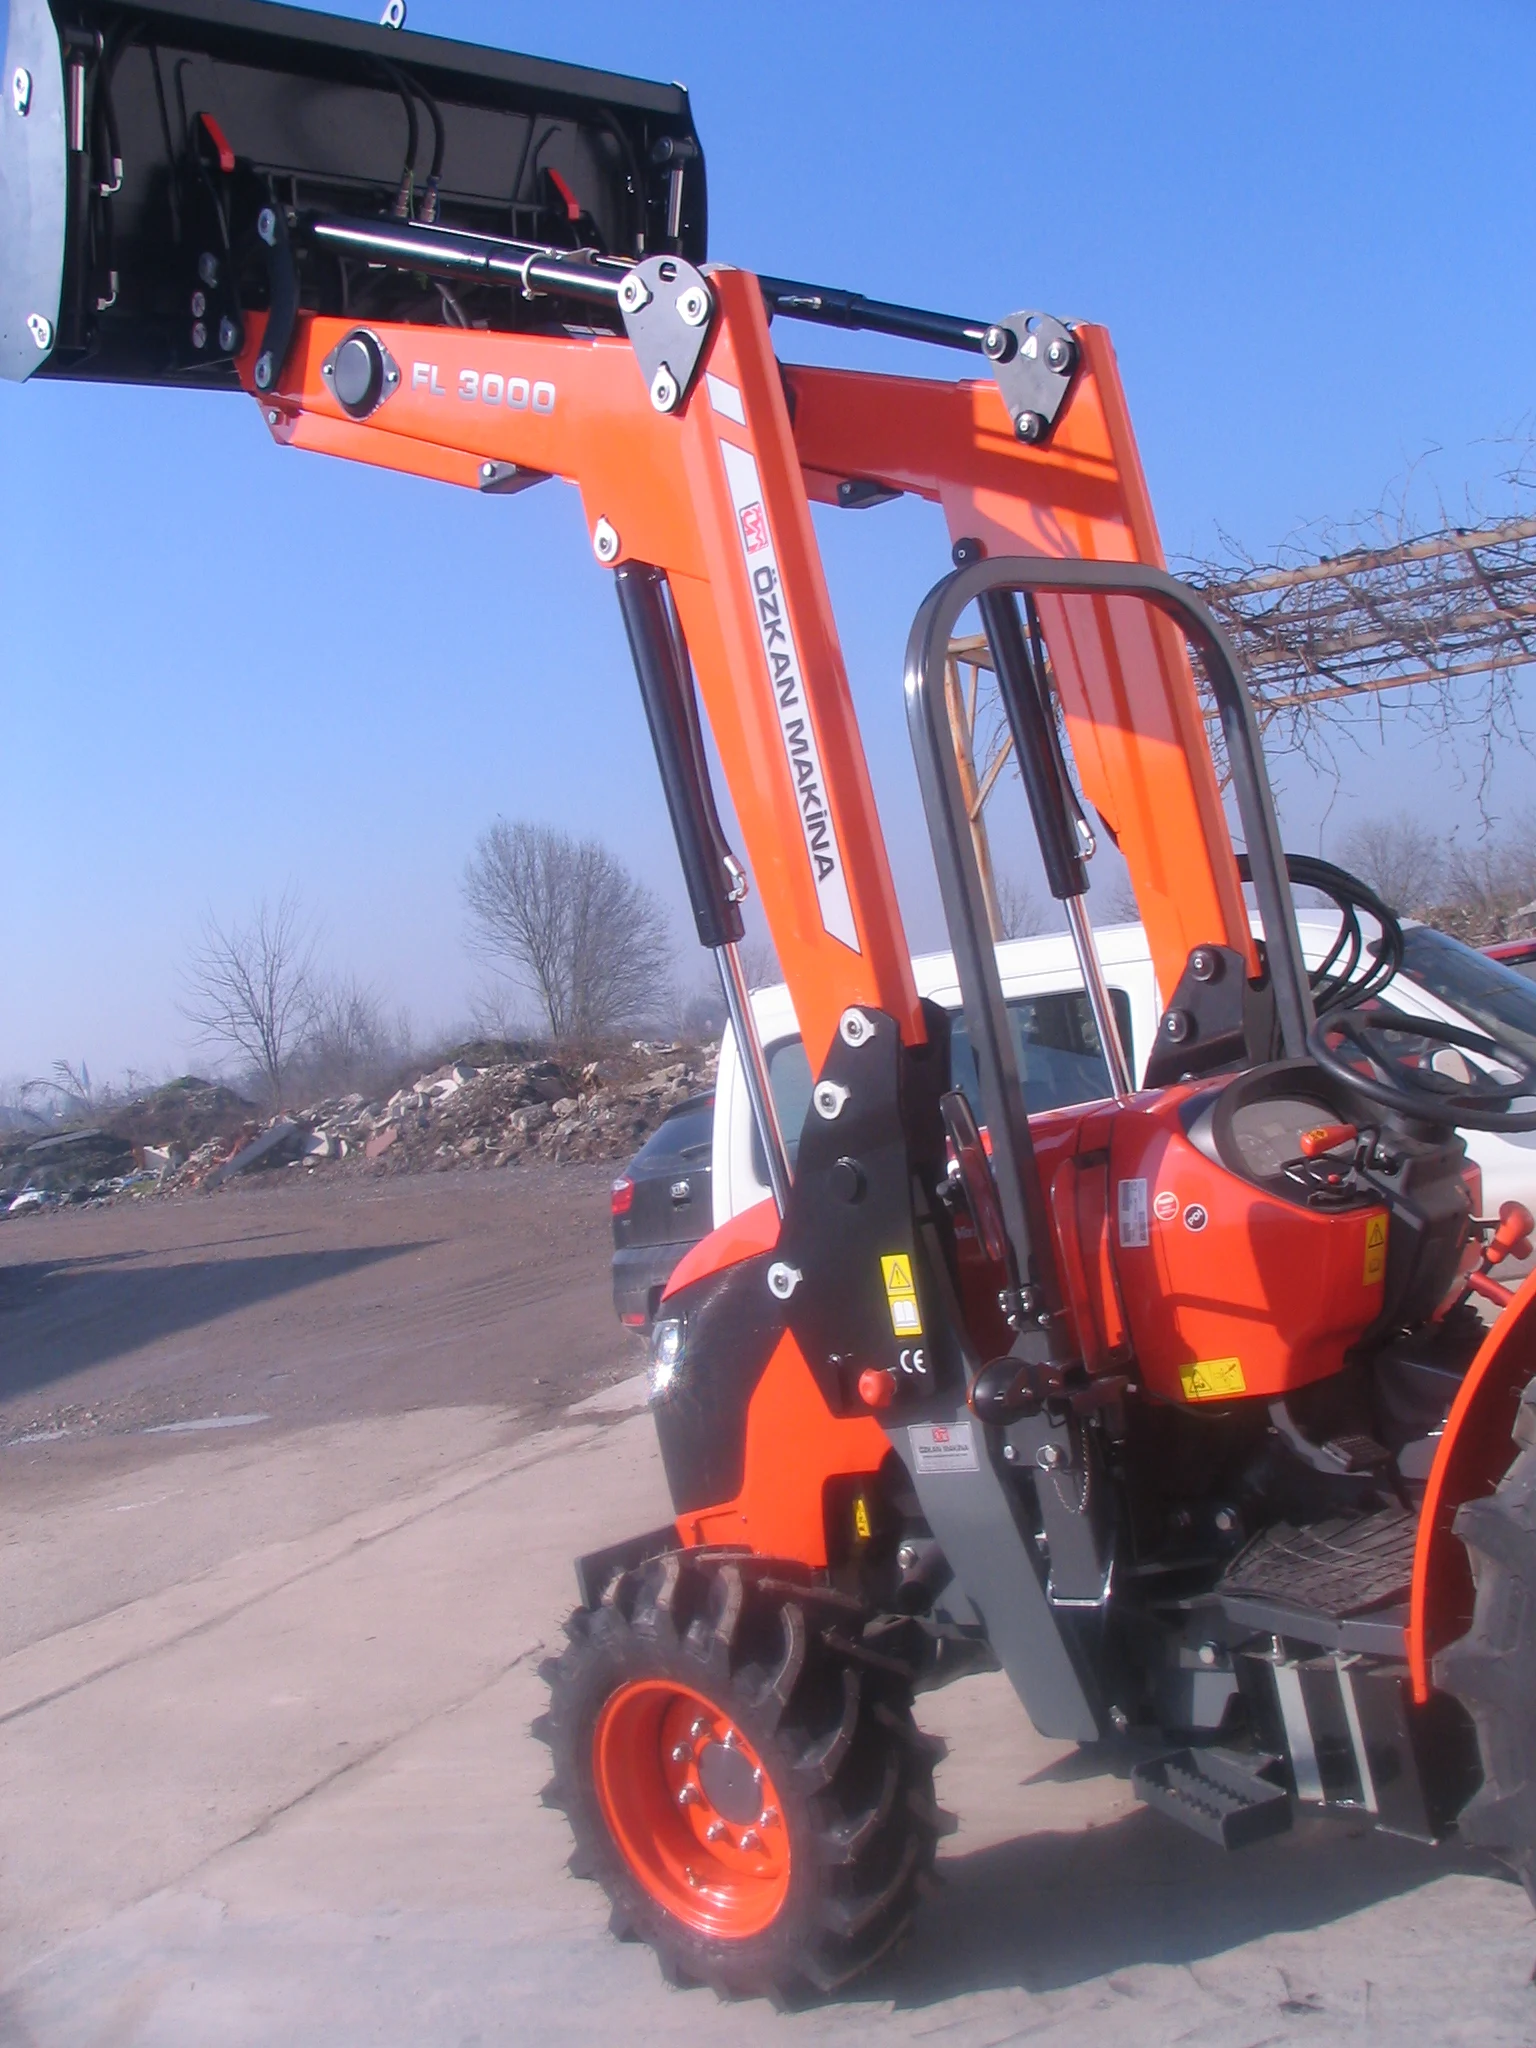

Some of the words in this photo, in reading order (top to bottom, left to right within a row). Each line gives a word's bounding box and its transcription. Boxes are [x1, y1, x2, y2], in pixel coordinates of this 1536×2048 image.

[411, 361, 446, 396] FL
[458, 368, 556, 414] 3000
[753, 565, 799, 708] ÖZKAN
[785, 718, 835, 882] MAKİNA
[900, 1349, 926, 1373] CE
